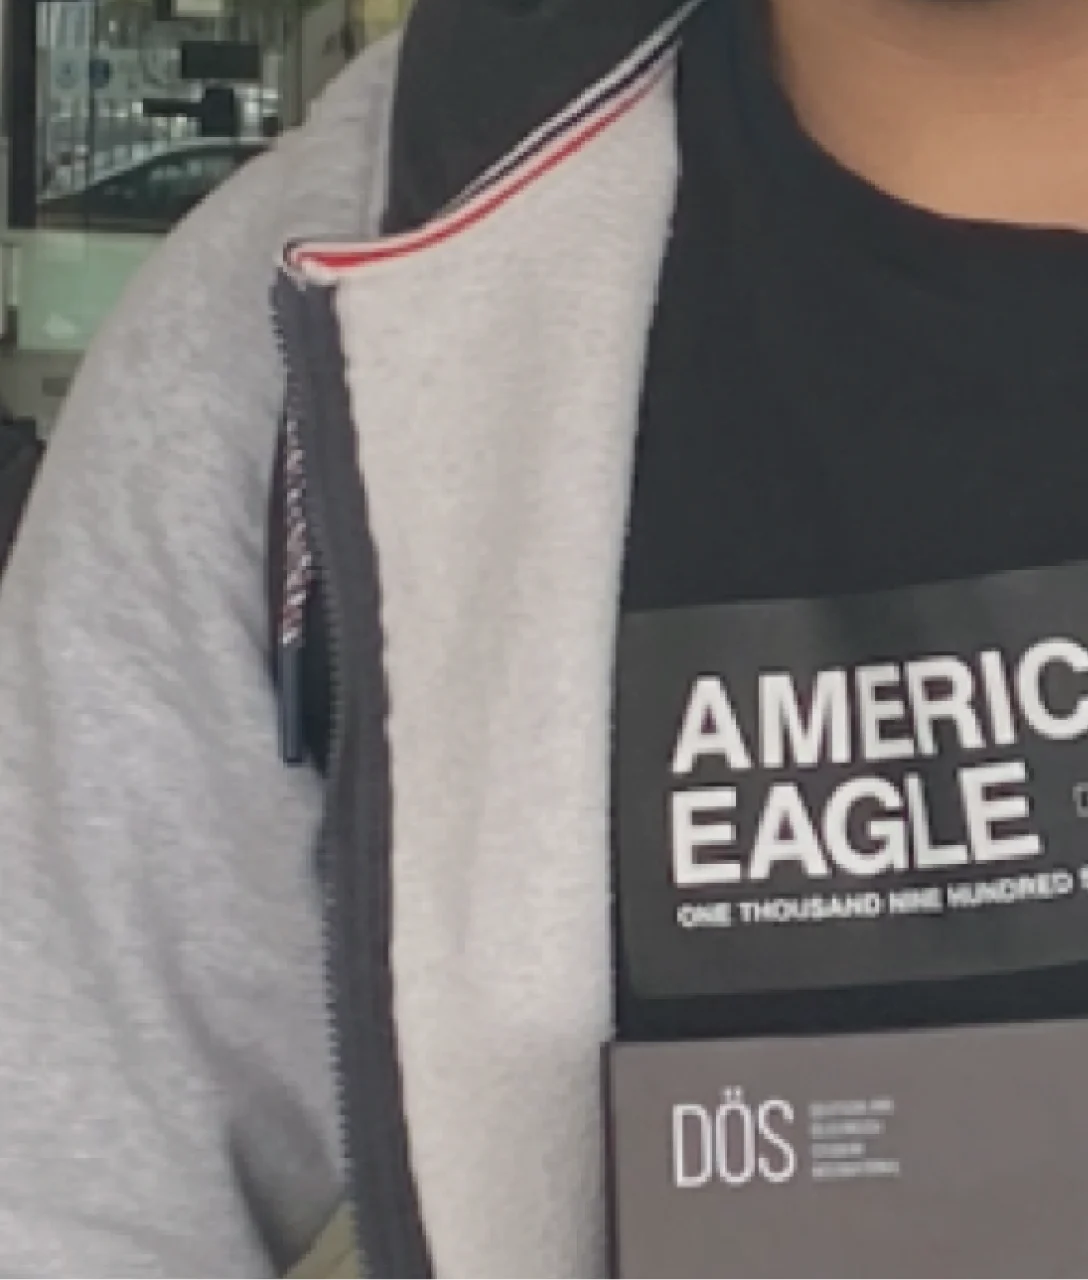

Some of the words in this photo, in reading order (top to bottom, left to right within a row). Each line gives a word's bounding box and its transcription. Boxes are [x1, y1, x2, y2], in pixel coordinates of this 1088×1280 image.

[670, 760, 1043, 887] EAGLE
[676, 902, 732, 928] ONE
[739, 891, 884, 923] THOUSAND
[947, 871, 1075, 907] HUNDRED
[671, 1085, 797, 1189] DÖS
